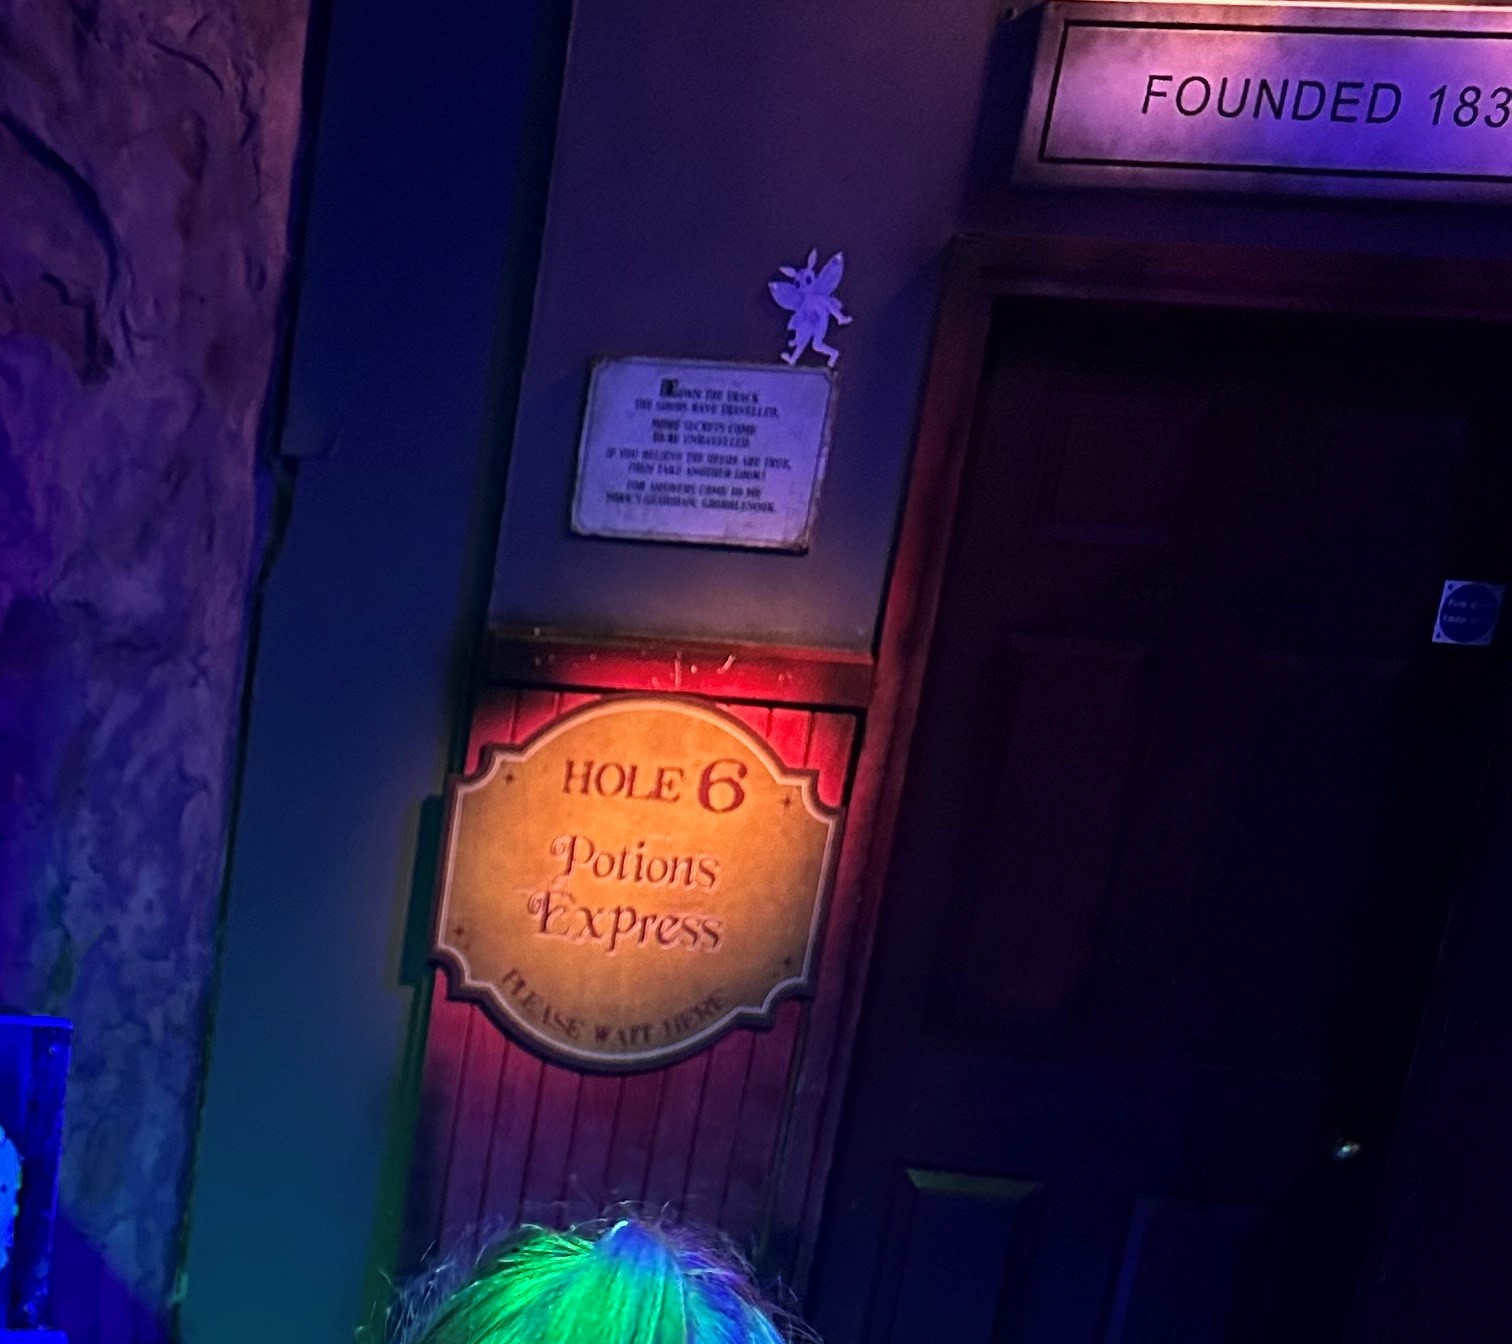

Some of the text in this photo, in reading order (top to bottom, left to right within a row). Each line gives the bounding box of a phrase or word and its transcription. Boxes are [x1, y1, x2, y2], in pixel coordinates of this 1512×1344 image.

[1142, 75, 1512, 128] FOUNDED 183
[563, 758, 748, 813] HOLE 6
[550, 834, 721, 889] Potions
[527, 889, 724, 955] Express
[502, 968, 584, 1041] PLEASE
[594, 1022, 653, 1047] WAIT
